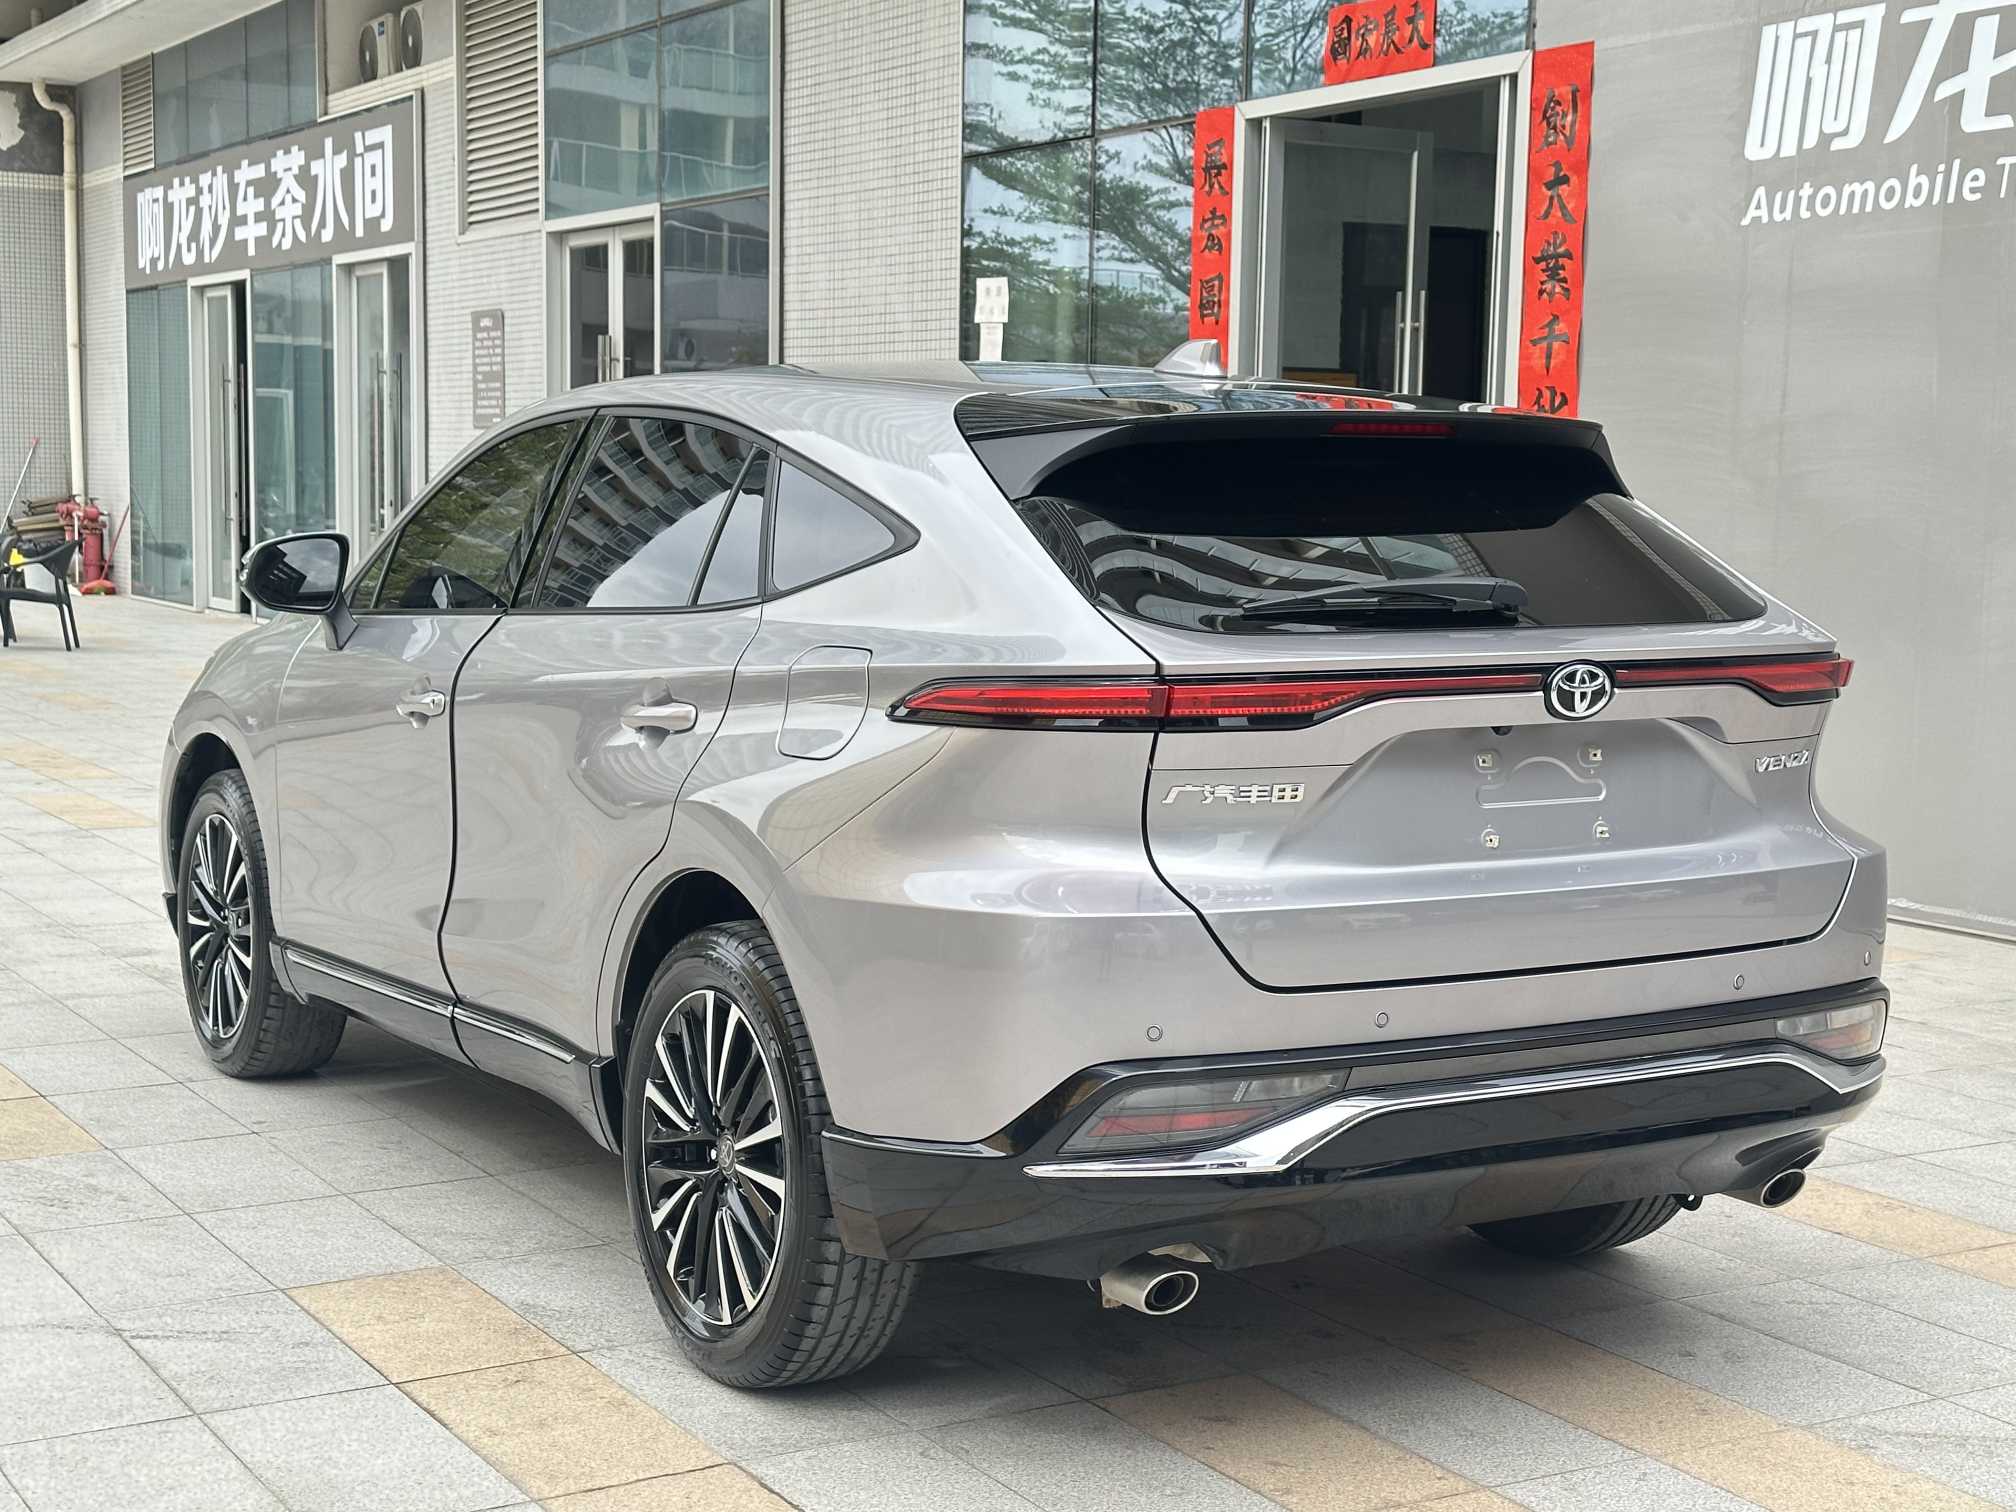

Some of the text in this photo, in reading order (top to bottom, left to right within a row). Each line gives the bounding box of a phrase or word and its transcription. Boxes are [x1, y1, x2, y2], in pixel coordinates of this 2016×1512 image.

[136, 124, 394, 274] 啊龙秒车茶水间
[1740, 158, 1986, 226] Automobile
[1754, 749, 1809, 773] VENZA
[1161, 783, 1305, 804] 广汽丰田
